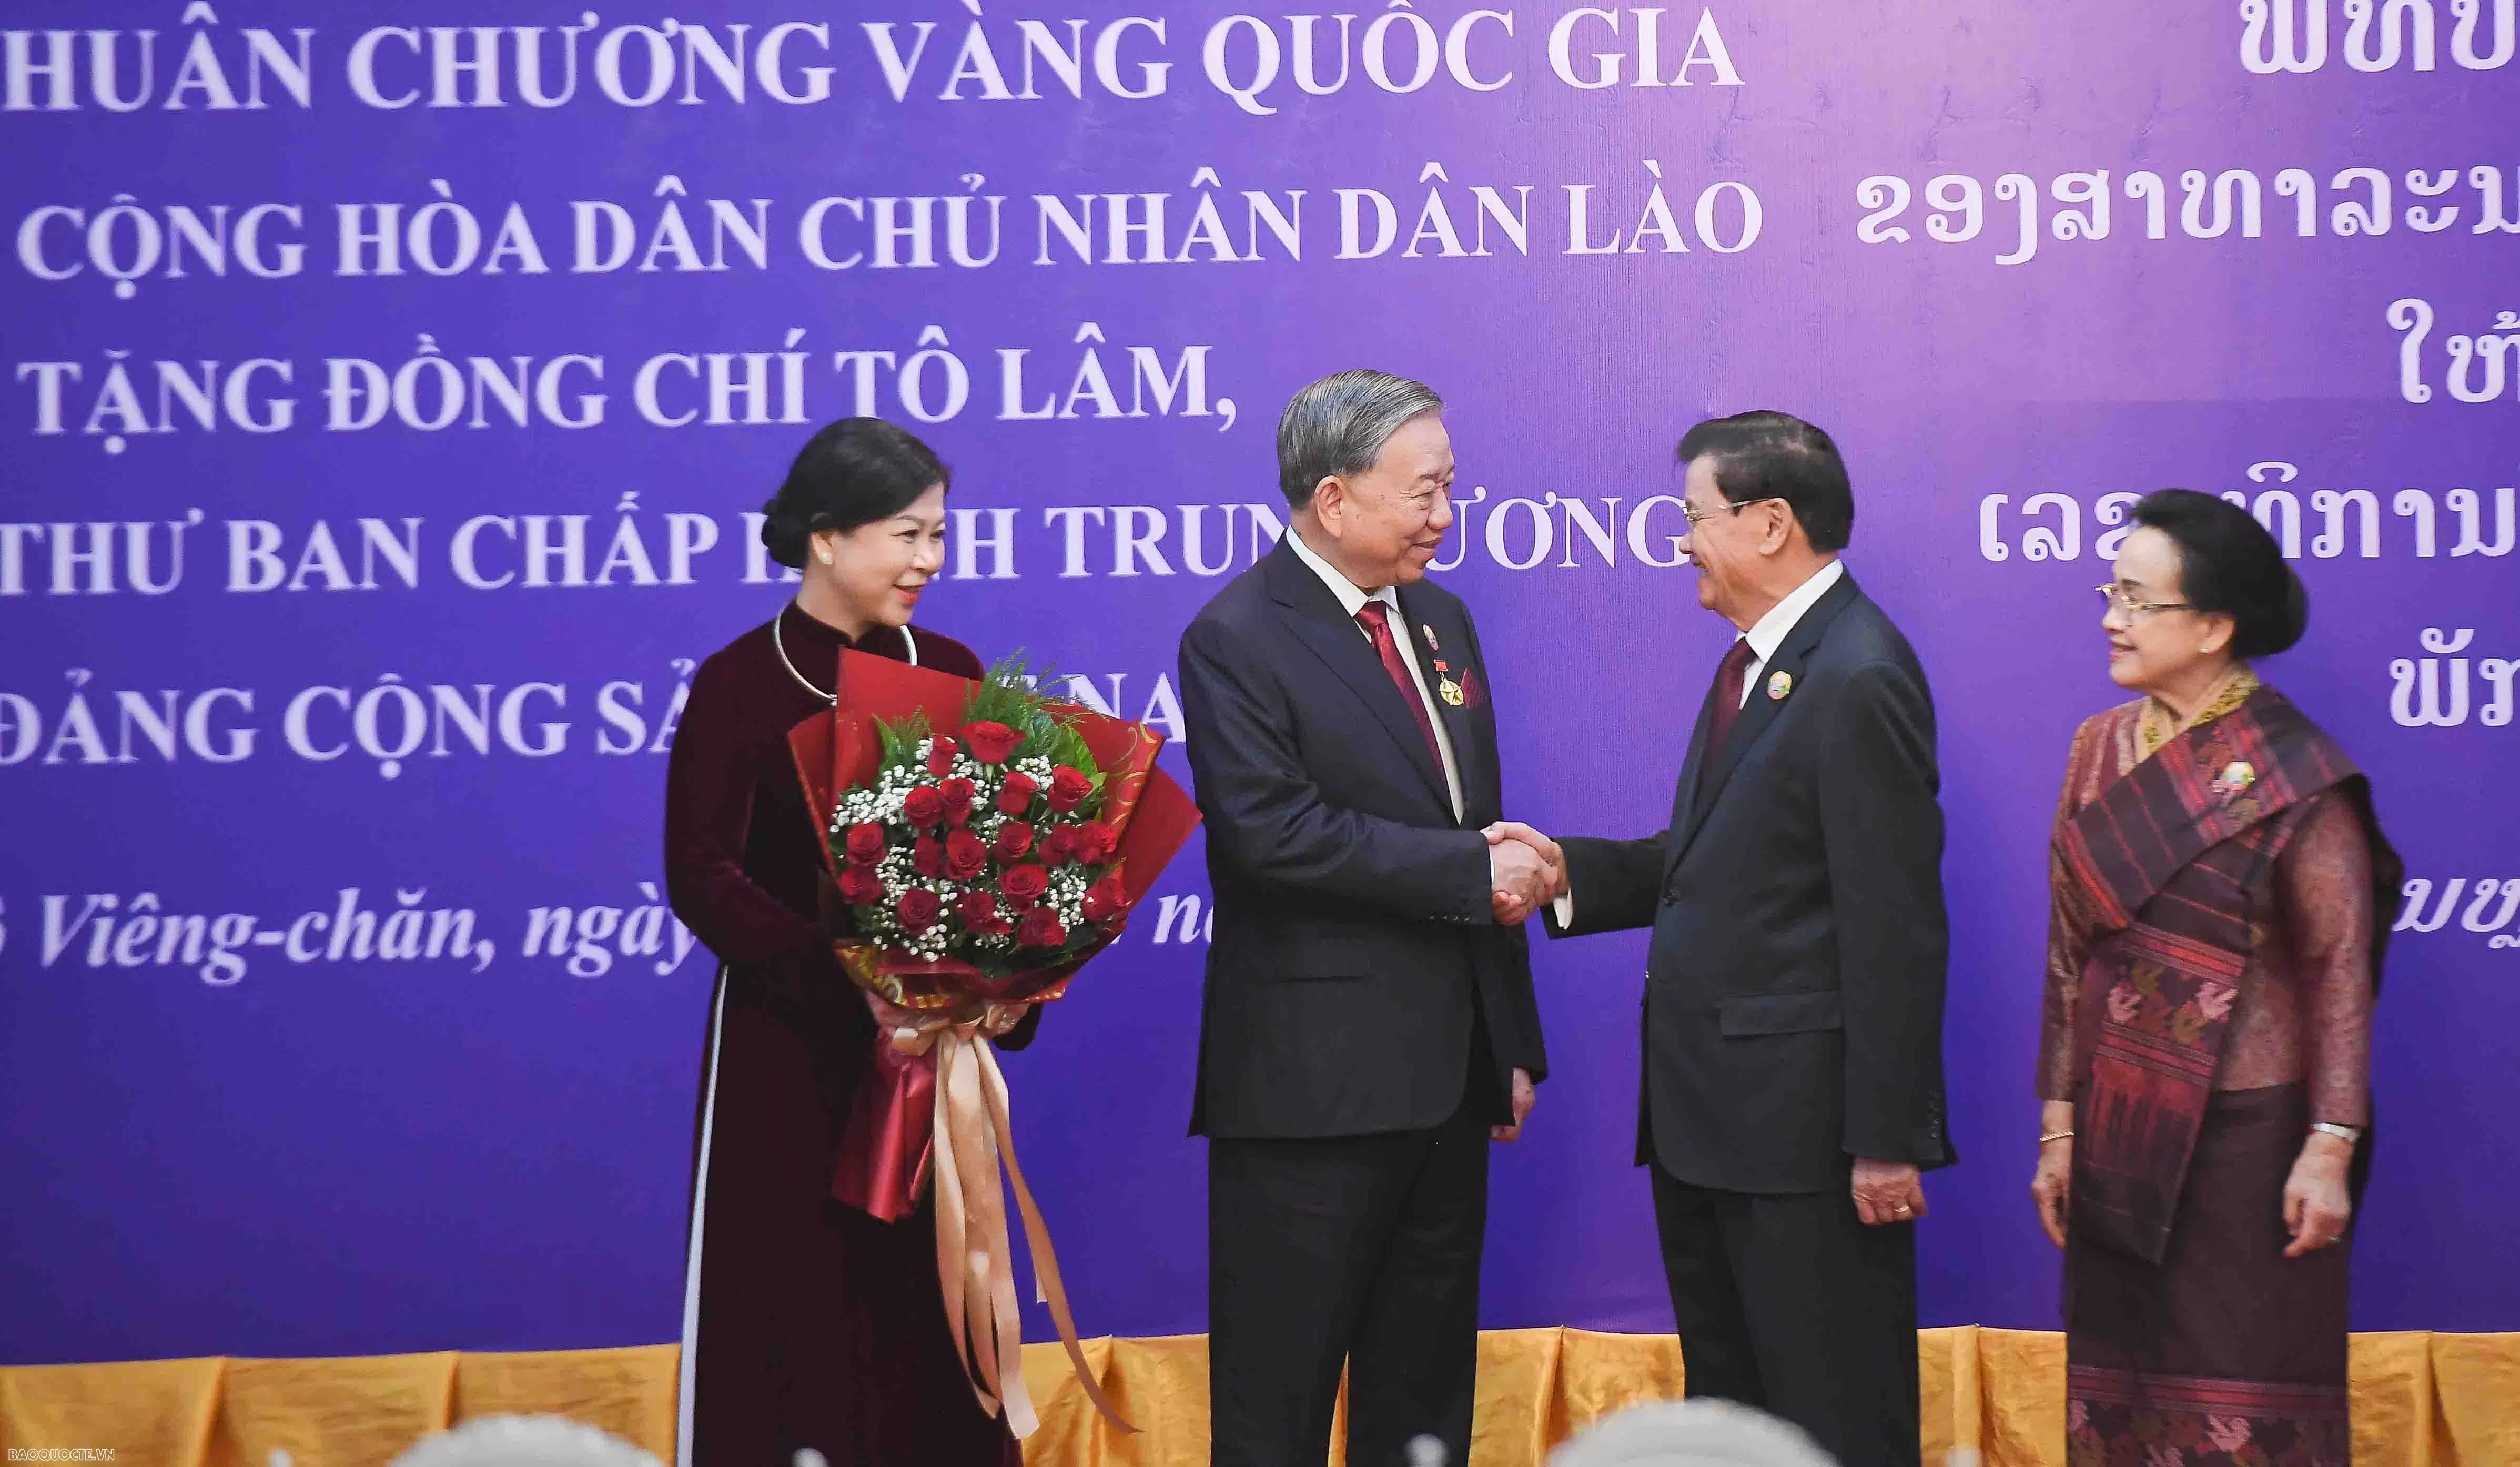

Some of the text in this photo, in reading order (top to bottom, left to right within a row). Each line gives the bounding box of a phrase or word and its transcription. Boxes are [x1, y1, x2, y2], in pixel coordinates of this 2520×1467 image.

[1, 0, 316, 113] HUÂN
[347, 9, 837, 109] CHƯƠNG
[859, 0, 1175, 103] VÀNG
[1547, 6, 1746, 90] GIA
[16, 158, 1763, 300] CỘNG HÒA DÂN CHỦ NHÂN DÂN LÀO
[16, 321, 1237, 456] TẶNG ĐỒNG CHÍ TÔ LÂM,
[0, 507, 205, 596] THƯ
[226, 516, 424, 593] BAN
[449, 490, 720, 590] CHẤP
[1044, 503, 1286, 579] TRUN
[283, 672, 572, 781] CỘNG
[41, 886, 496, 986] Viêng-chăn,
[521, 881, 697, 978] ngày
